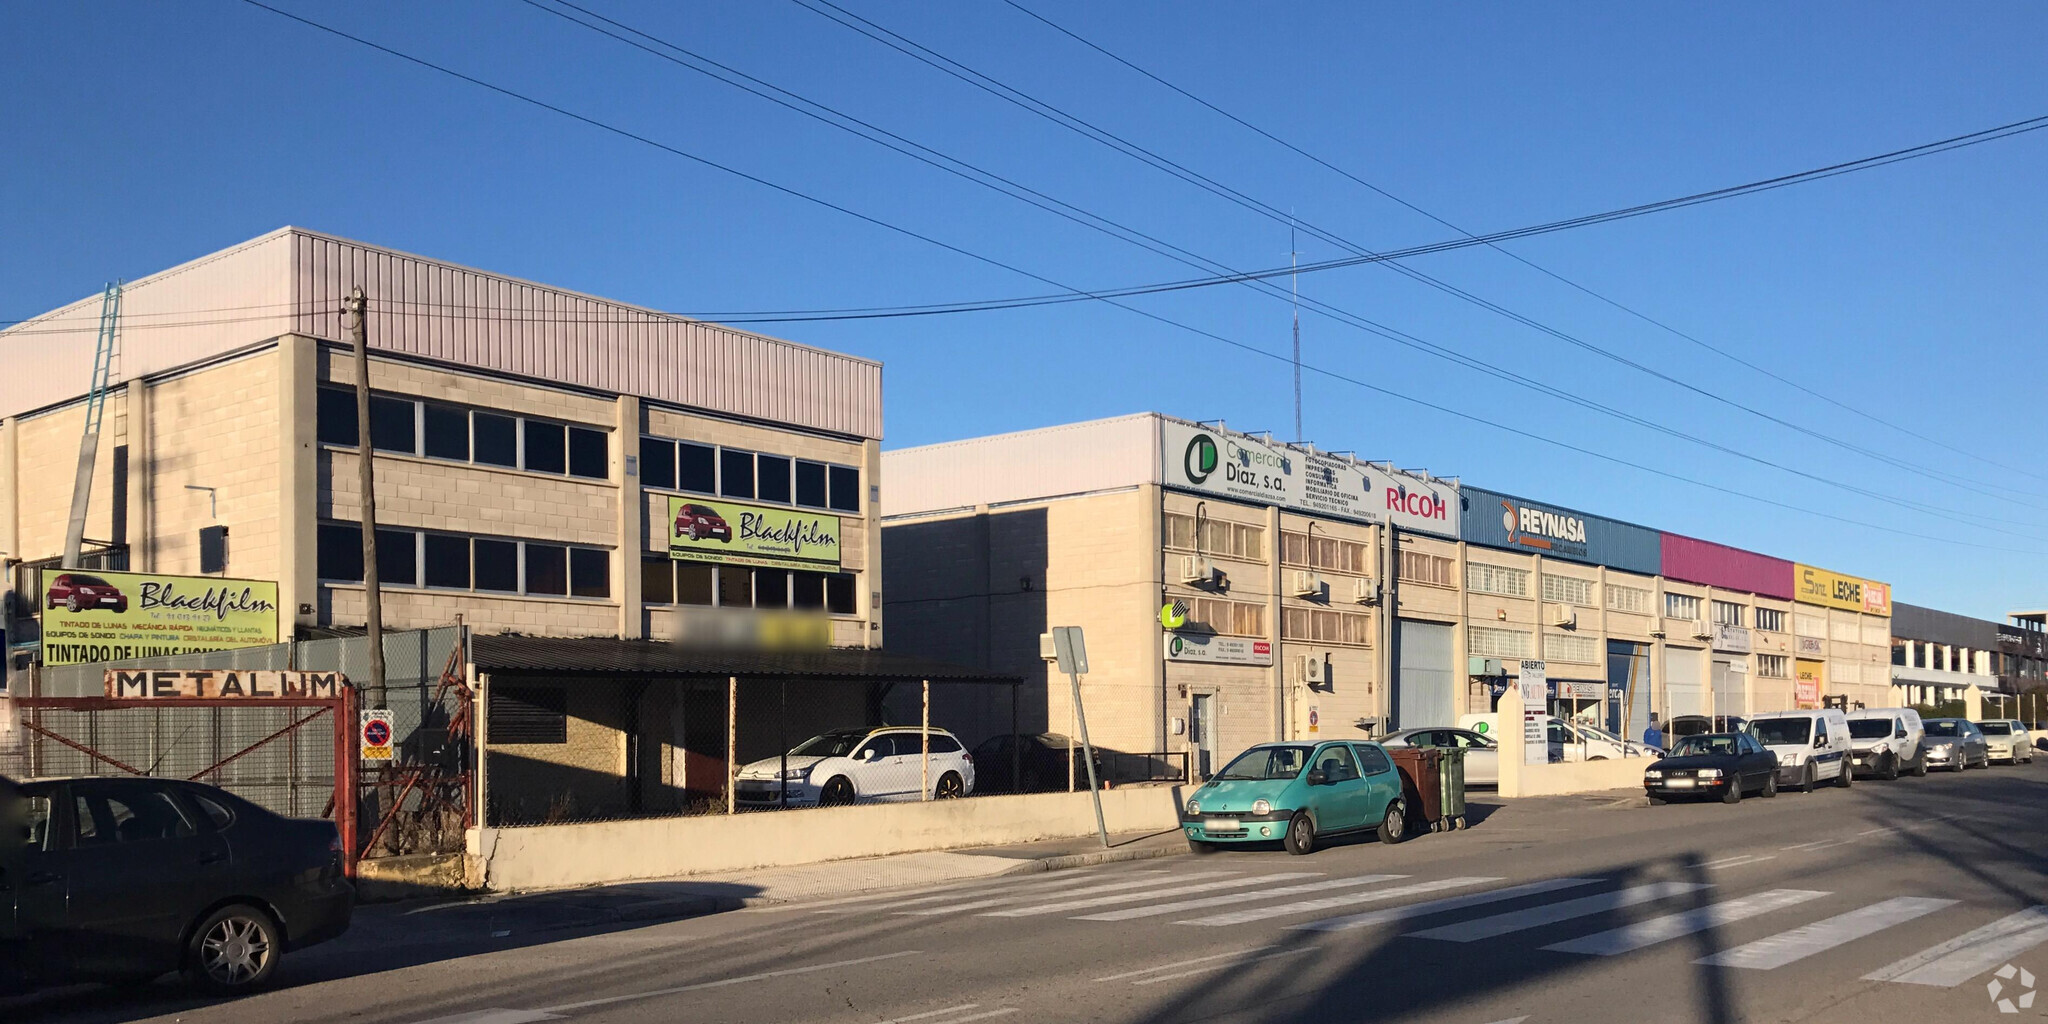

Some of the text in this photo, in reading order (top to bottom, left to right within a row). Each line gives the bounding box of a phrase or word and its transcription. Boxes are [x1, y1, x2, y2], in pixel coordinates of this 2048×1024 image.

[1305, 456, 1346, 471] FOTOCOPIADORAS
[1226, 462, 1286, 492] Díaz, s.a.
[1306, 485, 1333, 496] MOBILIARIO
[1340, 492, 1358, 501] OFICINA
[1306, 492, 1348, 506] SERVICIO TECNICO
[1386, 488, 1446, 520] RICOH
[740, 512, 836, 554] Blackfilm
[1520, 507, 1586, 543] REYNASA
[140, 582, 275, 620] Blackfilm
[1832, 579, 1860, 603] LECHE
[47, 644, 110, 662] TINTADO
[114, 646, 131, 660] DE
[1521, 660, 1545, 670] ABIERTO
[117, 672, 336, 698] METALUM
